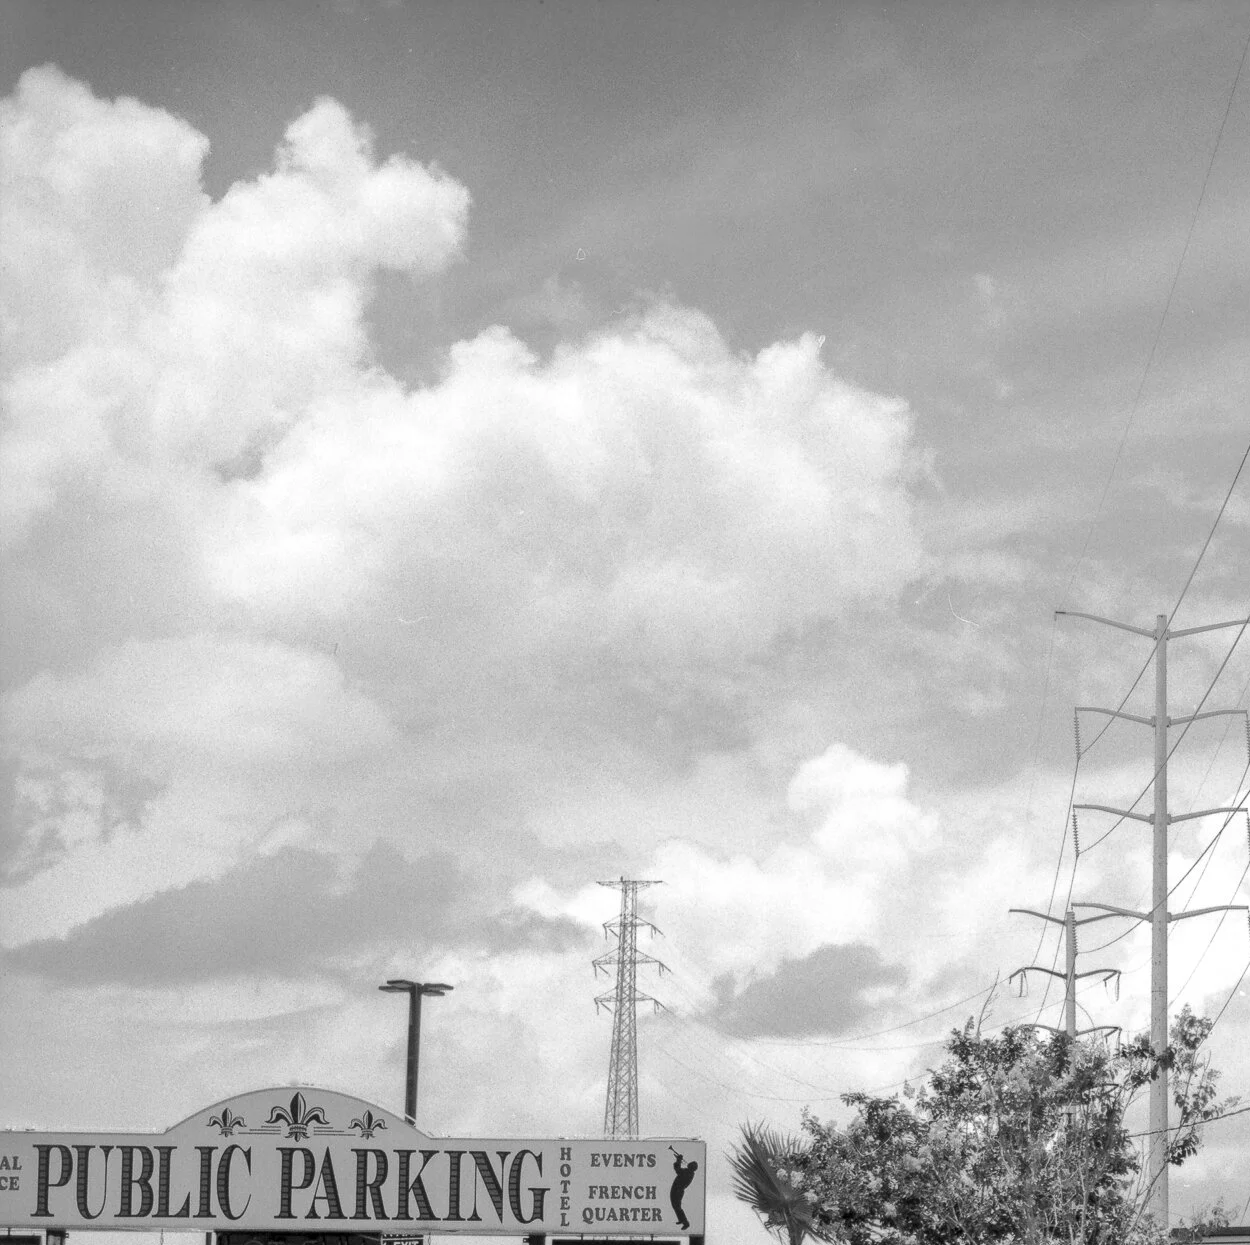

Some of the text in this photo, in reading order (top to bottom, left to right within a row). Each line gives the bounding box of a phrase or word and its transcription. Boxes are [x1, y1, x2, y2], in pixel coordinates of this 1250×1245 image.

[590, 1153, 657, 1168] EVENTS
[30, 1143, 551, 1225] PUBLIC PARKING
[559, 1147, 572, 1227] HOTEL
[588, 1185, 657, 1200] FRENCH
[582, 1207, 663, 1224] QUARTER
